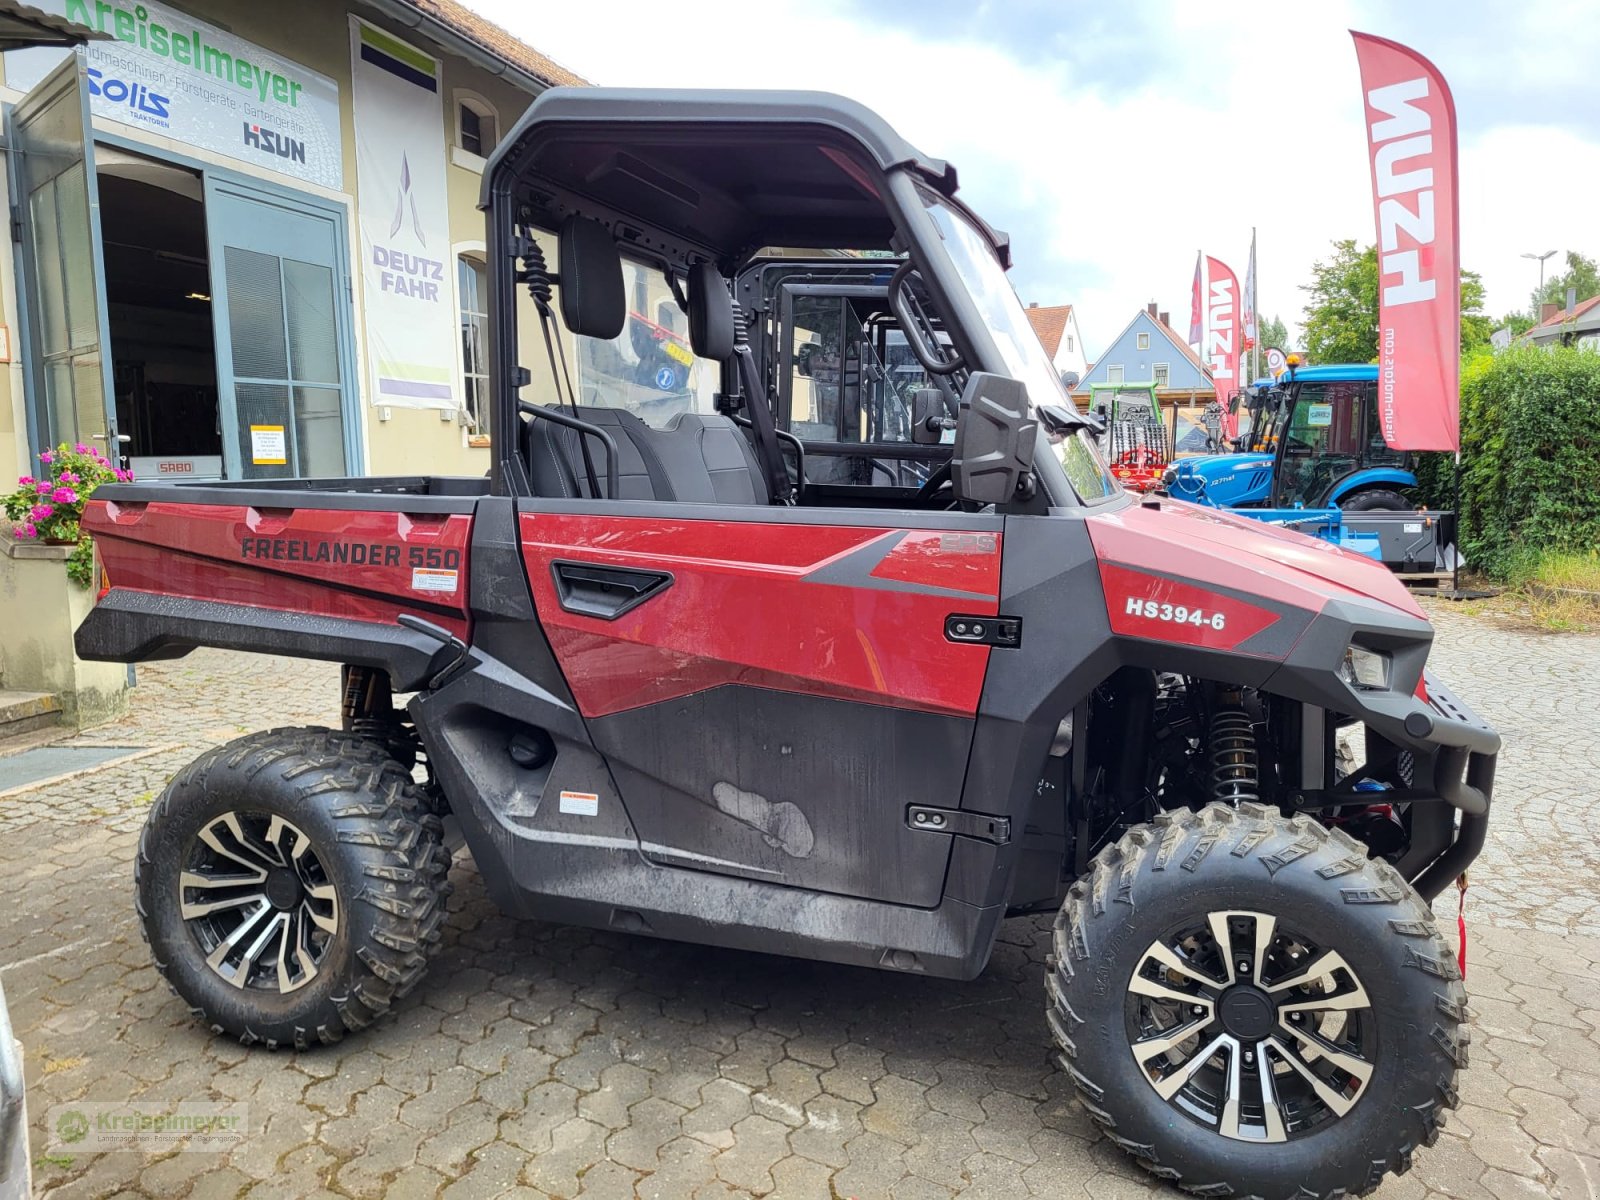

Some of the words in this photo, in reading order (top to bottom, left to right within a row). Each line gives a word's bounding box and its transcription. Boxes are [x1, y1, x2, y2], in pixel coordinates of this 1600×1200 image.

[75, 44, 166, 84] andmaschinen
[175, 77, 236, 109] Forstgeräte
[244, 103, 304, 134] Gartengeräte
[130, 111, 169, 128] TRAKTOREN
[373, 245, 443, 281] DEUTZ
[381, 271, 438, 303] FAHR
[160, 462, 192, 473] SABO
[241, 537, 400, 567] FREELANDER
[408, 546, 460, 570] 550
[1126, 598, 1225, 630] HS394-6
